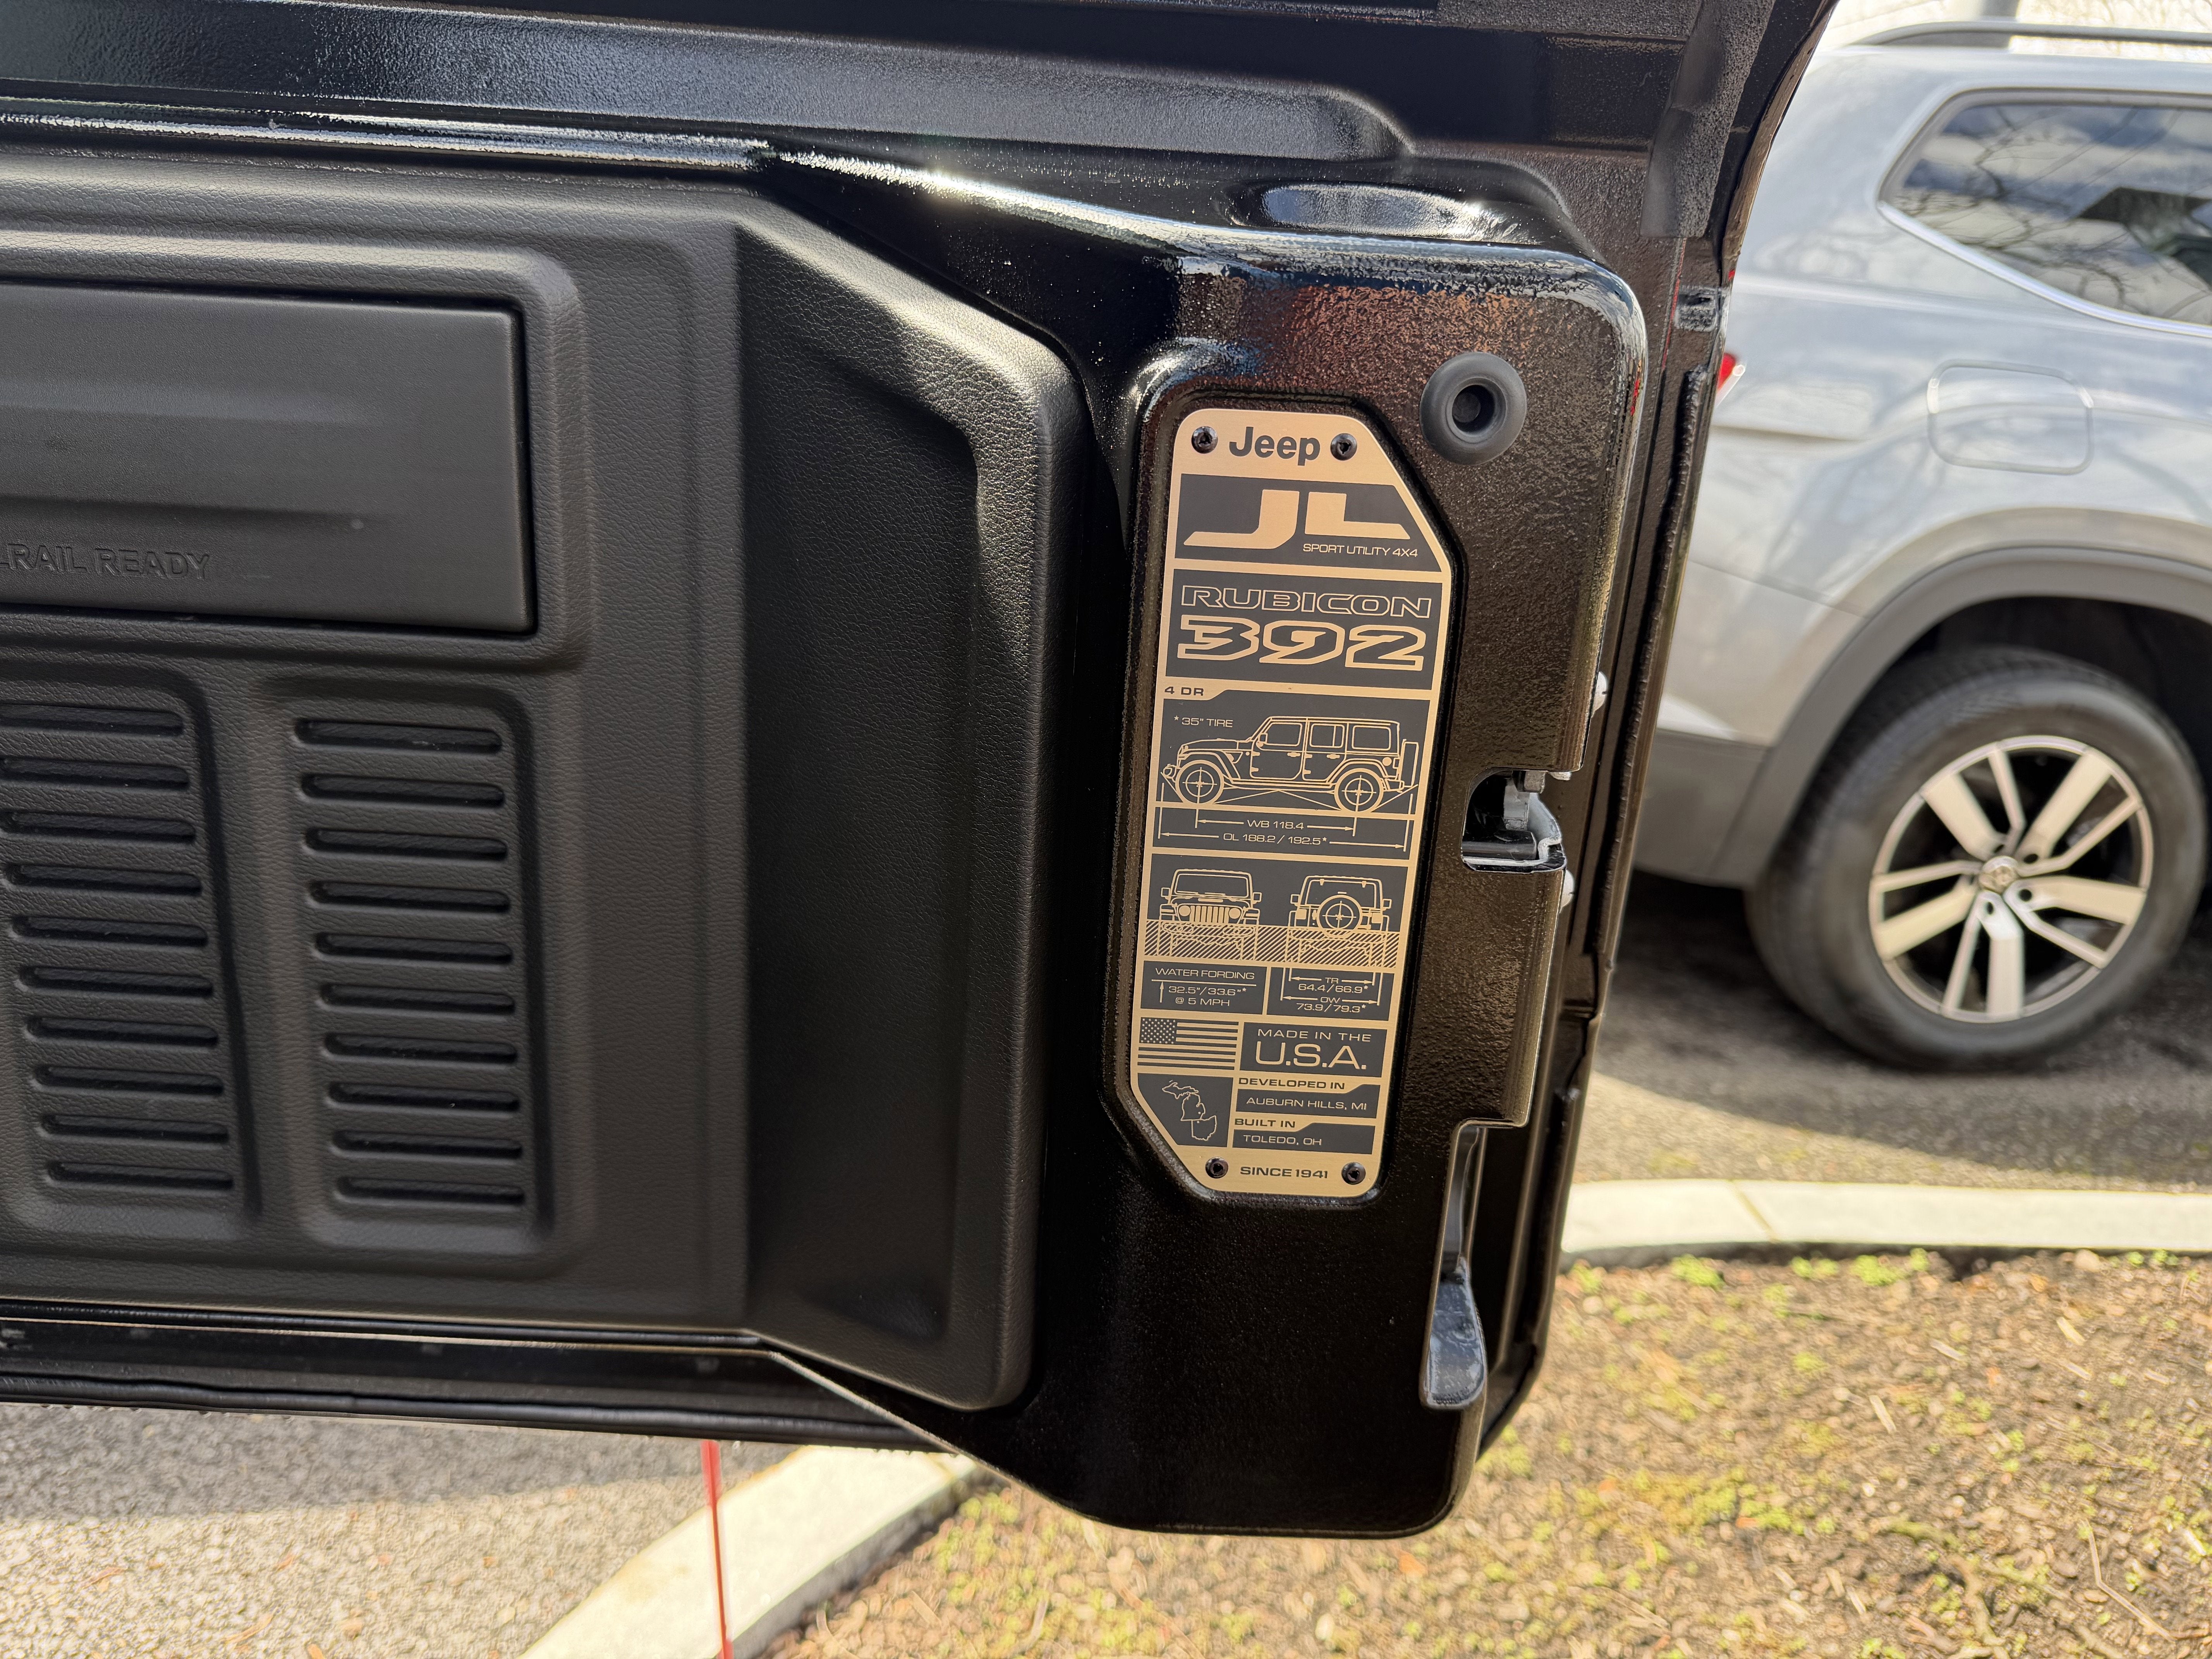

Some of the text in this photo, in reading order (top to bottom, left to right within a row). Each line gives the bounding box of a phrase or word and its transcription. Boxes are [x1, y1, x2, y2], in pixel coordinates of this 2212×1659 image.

[1229, 426, 1320, 466] Jeep
[1183, 489, 1411, 550] JL
[1303, 543, 1418, 558] SPORT UTILITY 4X4
[0, 543, 210, 580] RAIL READY
[1181, 585, 1432, 618] RUBICON
[1177, 615, 1426, 672] 392
[1181, 687, 1204, 696] DR
[1206, 718, 1233, 728] TIRE
[1247, 819, 1304, 830] WB 118.4
[1223, 833, 1239, 841] OL
[1155, 967, 1255, 980] WATER FORDING
[1200, 998, 1230, 1006] MPH
[1257, 1029, 1371, 1042] MADE IN THE
[1255, 1041, 1367, 1070] U.S.A.
[1238, 1077, 1327, 1089] DEVELOPED
[1246, 1097, 1304, 1108] AUBURN
[1307, 1100, 1347, 1110] HILLS,
[1234, 1118, 1276, 1127] BUILT
[1243, 1135, 1299, 1146] TOLEDO,
[1240, 1166, 1328, 1179] SINCE 1941
